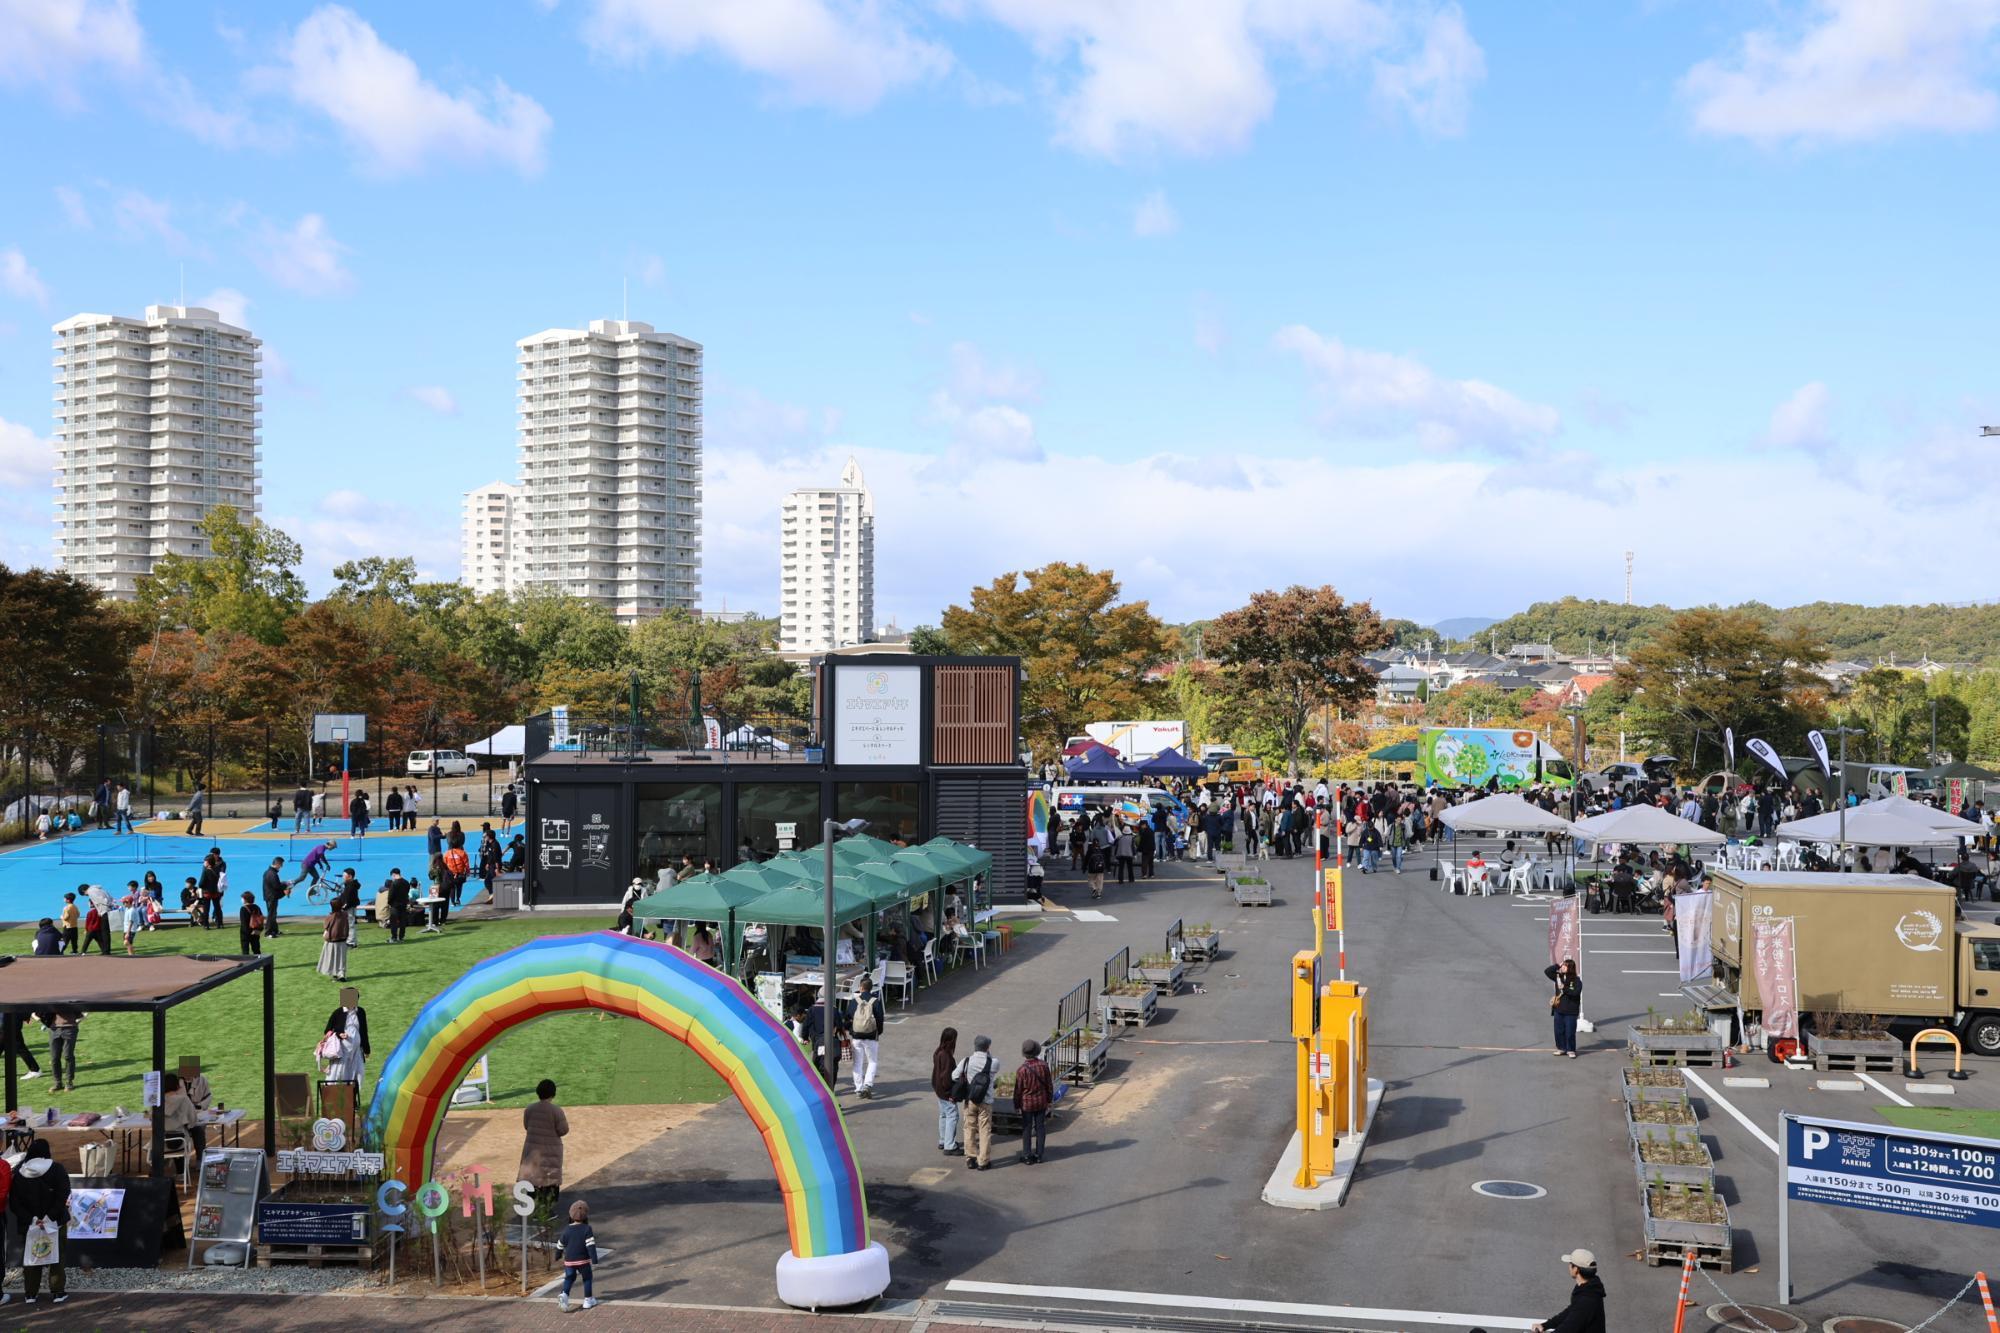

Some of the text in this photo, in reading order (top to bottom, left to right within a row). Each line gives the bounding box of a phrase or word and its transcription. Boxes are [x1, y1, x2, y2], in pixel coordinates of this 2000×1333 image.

[1772, 937, 1789, 1006] 米粉チュロス
[1803, 1125, 1830, 1160] P
[277, 1149, 381, 1175] エキマエアキチ
[1841, 1158, 1872, 1168] PARKING
